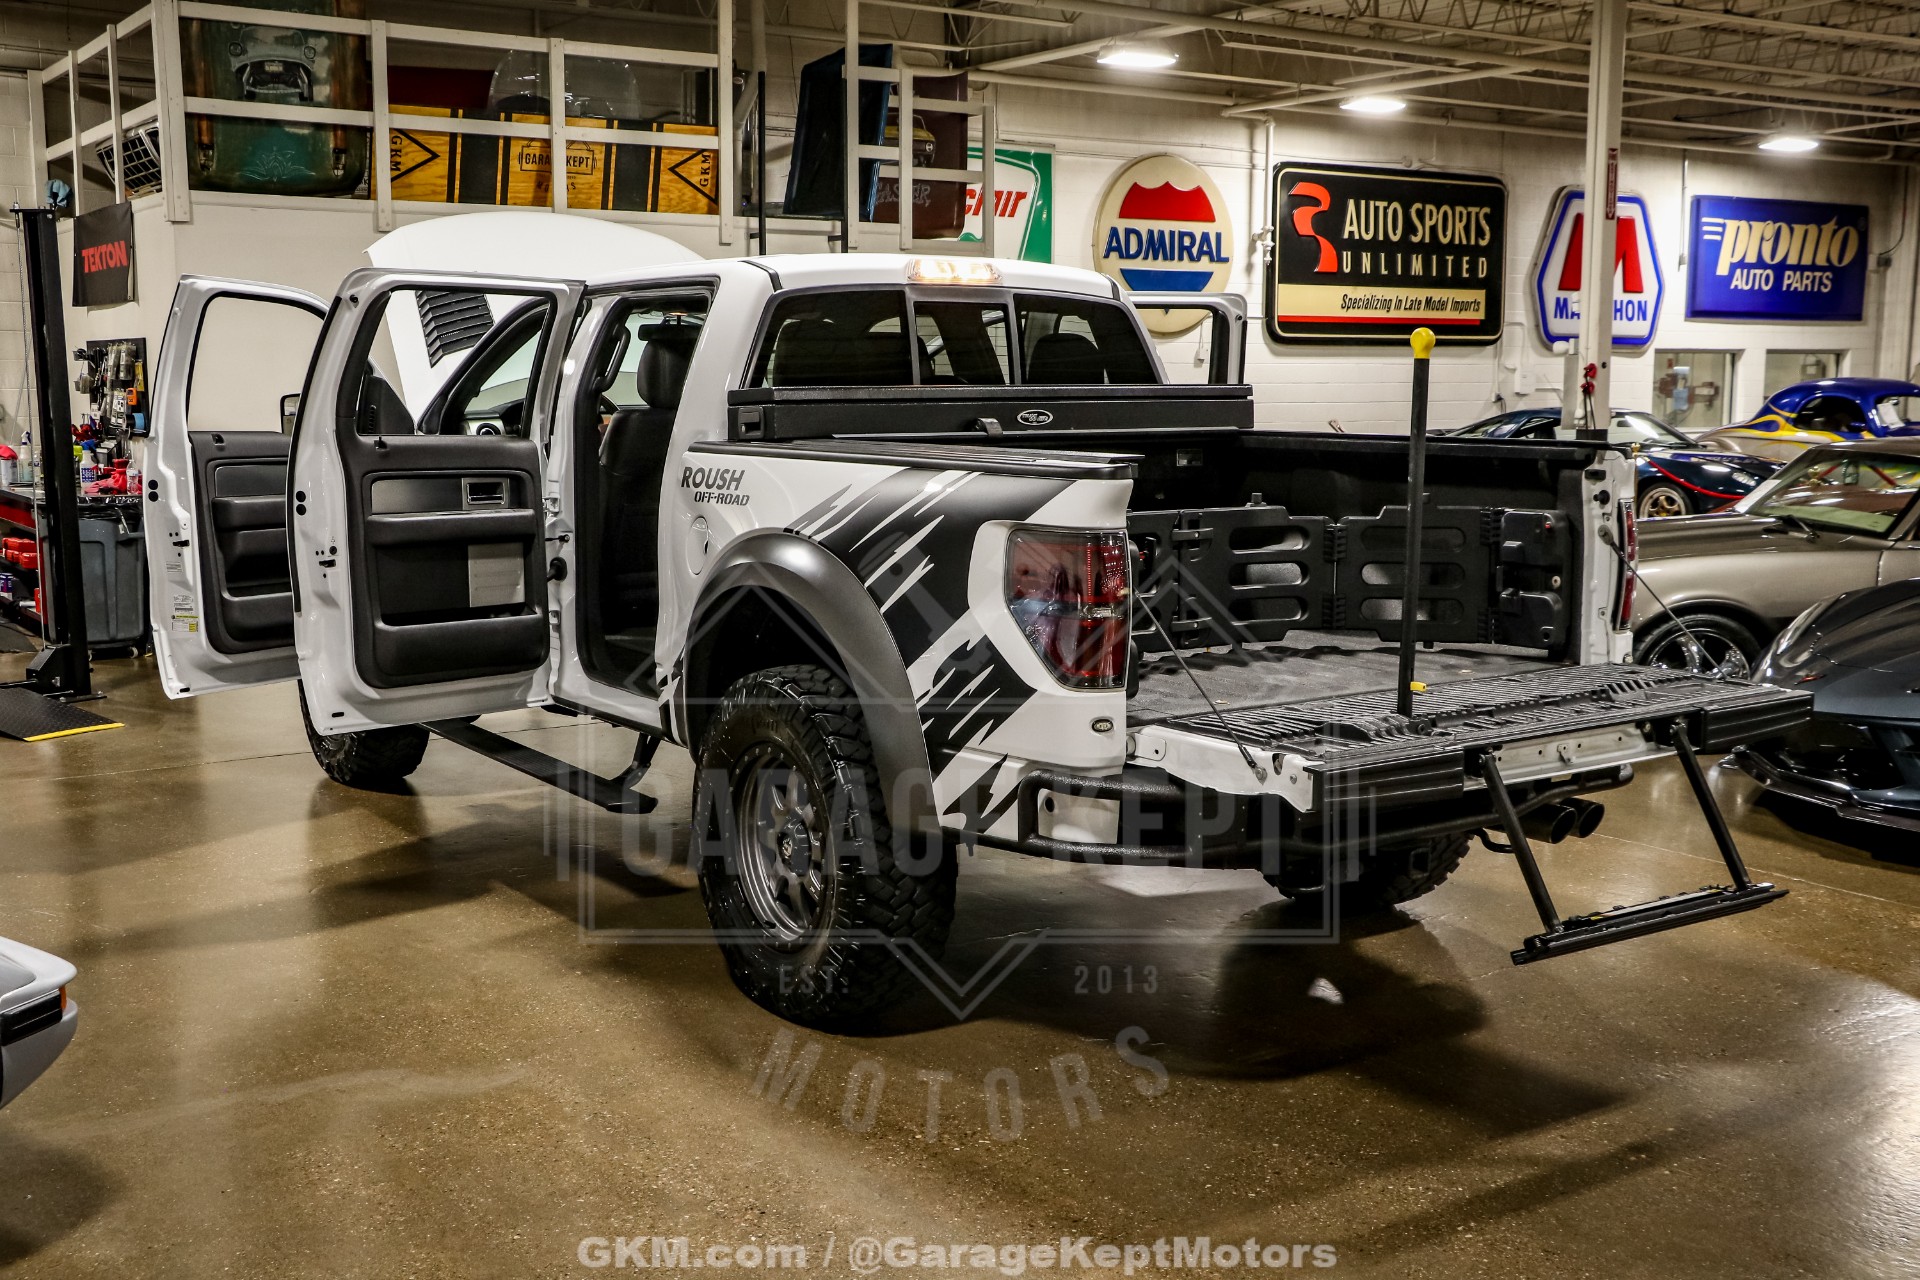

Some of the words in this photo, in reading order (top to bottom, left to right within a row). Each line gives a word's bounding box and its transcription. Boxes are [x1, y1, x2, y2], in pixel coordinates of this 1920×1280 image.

[390, 135, 403, 172] GKM
[524, 153, 551, 166] GARA
[566, 155, 590, 168] KEPT
[699, 153, 711, 187] GKM
[965, 188, 1028, 218] clir
[1343, 199, 1403, 242] AUTO
[1411, 203, 1491, 246] SPORTS
[82, 240, 128, 273] TEKTON
[1103, 226, 1230, 263] ADMIRAL
[1716, 216, 1859, 276] pronto
[1342, 251, 1488, 278] UNLIMITED
[1730, 269, 1774, 291] AUTO
[1782, 271, 1833, 293] PARTS
[1341, 294, 1392, 312] Specializing
[1394, 296, 1403, 311] In
[1404, 297, 1423, 312] Late
[1423, 297, 1449, 312] Model
[1450, 298, 1480, 315] Imports
[1554, 297, 1648, 321] MHON
[681, 466, 746, 491] ROUSH
[694, 491, 751, 507] OFF-ROAD
